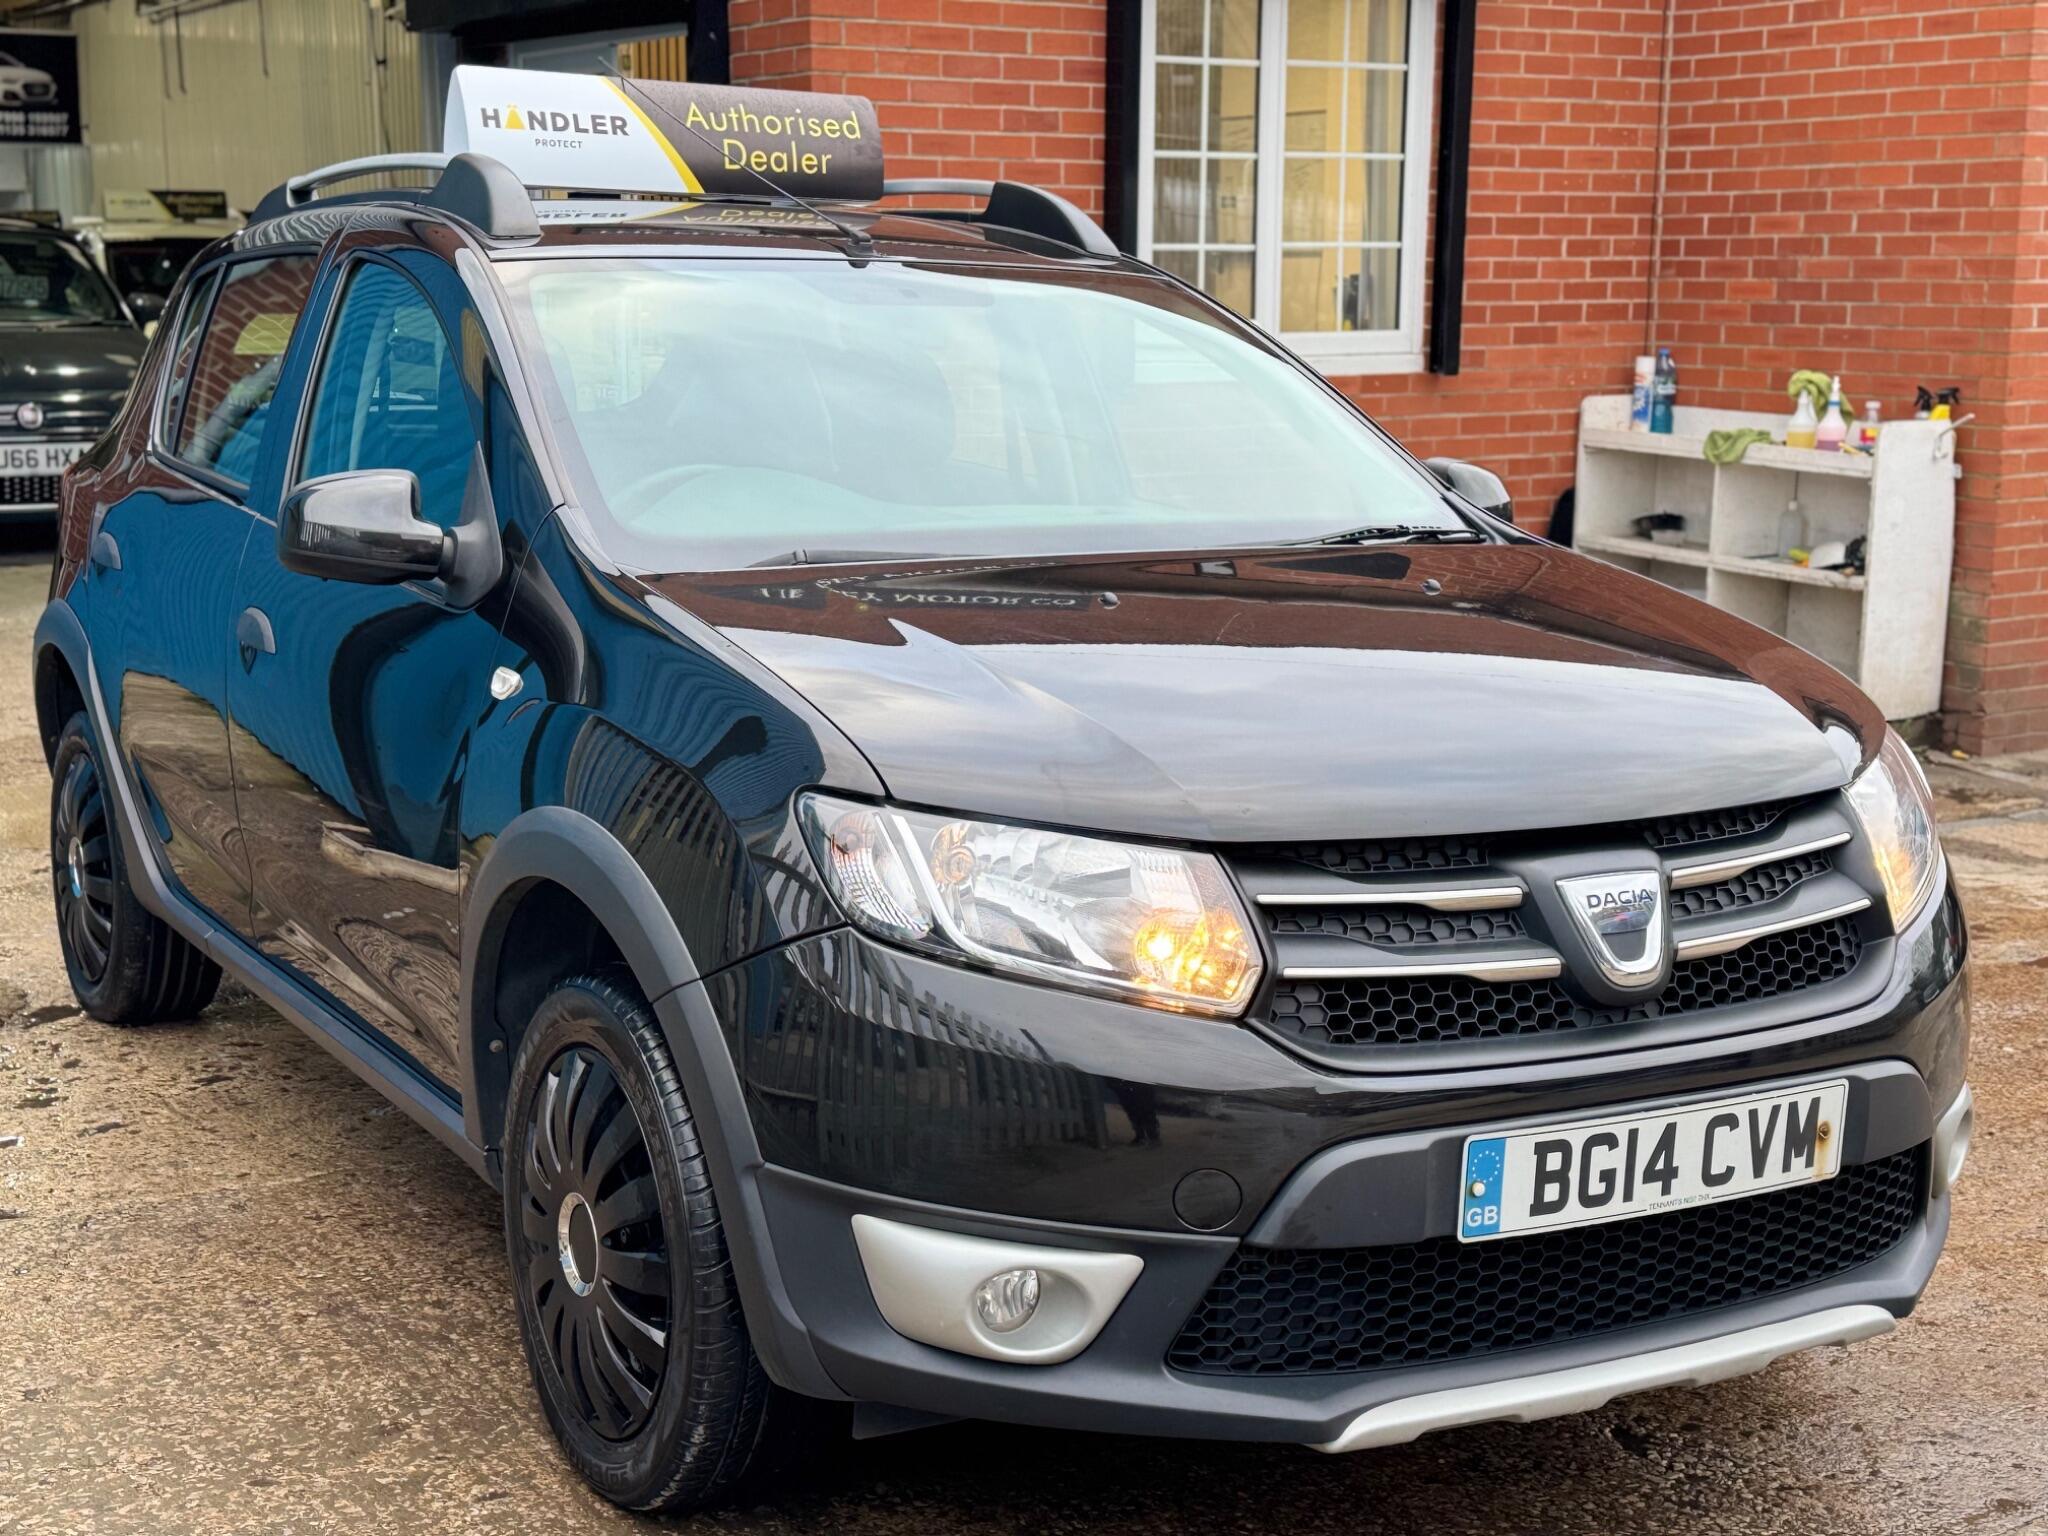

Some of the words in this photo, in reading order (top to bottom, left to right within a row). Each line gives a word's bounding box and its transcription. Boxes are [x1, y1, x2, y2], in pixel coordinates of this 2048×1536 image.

[685, 101, 861, 140] Authorised
[534, 138, 583, 149] PROTECT
[723, 138, 832, 175] Dealer
[45, 448, 84, 469] HX
[1586, 889, 1653, 909] DACIA
[1529, 1122, 1679, 1217] BG14
[1701, 1096, 1822, 1188] CVM
[1466, 1205, 1498, 1228] GB
